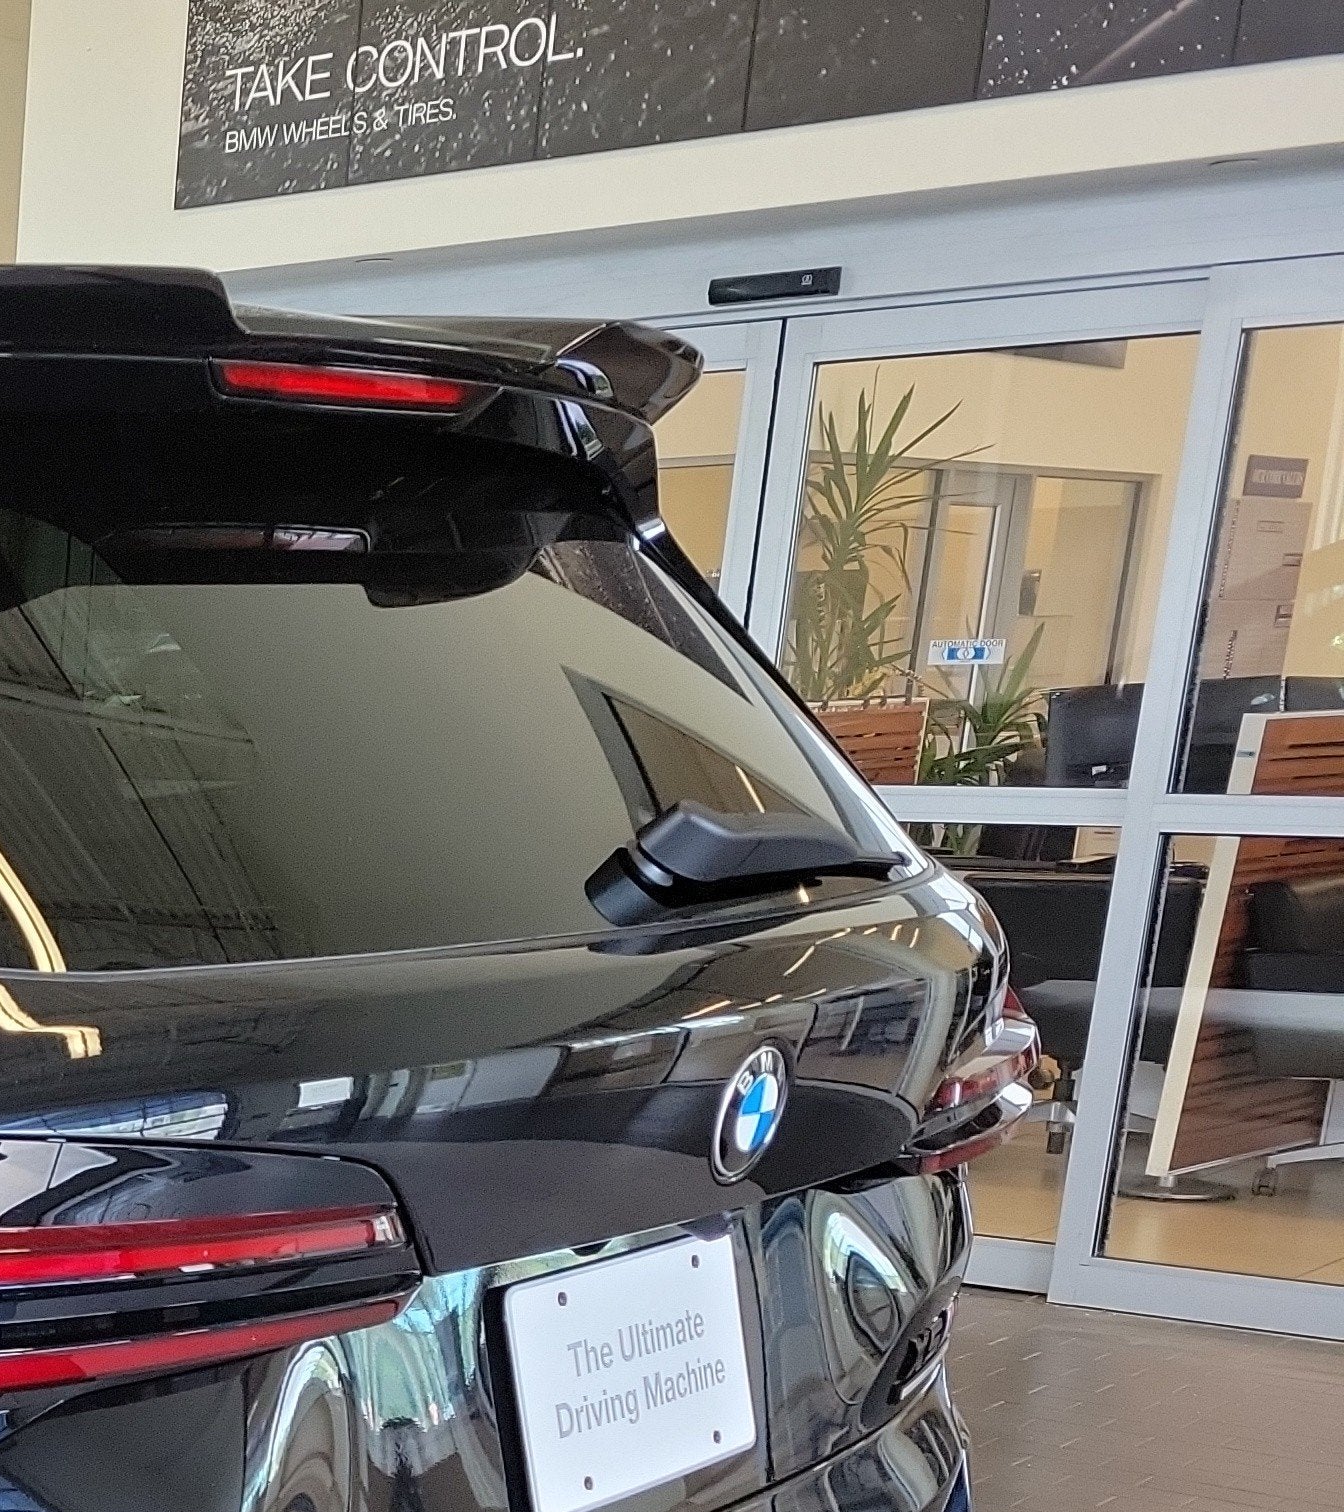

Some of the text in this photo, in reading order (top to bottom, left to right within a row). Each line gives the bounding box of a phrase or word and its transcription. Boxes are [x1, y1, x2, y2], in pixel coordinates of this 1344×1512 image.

[224, 14, 584, 112] TAKE CONTROL.
[224, 98, 457, 153] BMW WHEELS & TIRES.
[932, 639, 1003, 648] AUTOMATIC DOOR
[567, 1308, 707, 1379] The Ultimate
[555, 1357, 727, 1440] Driving Machine
